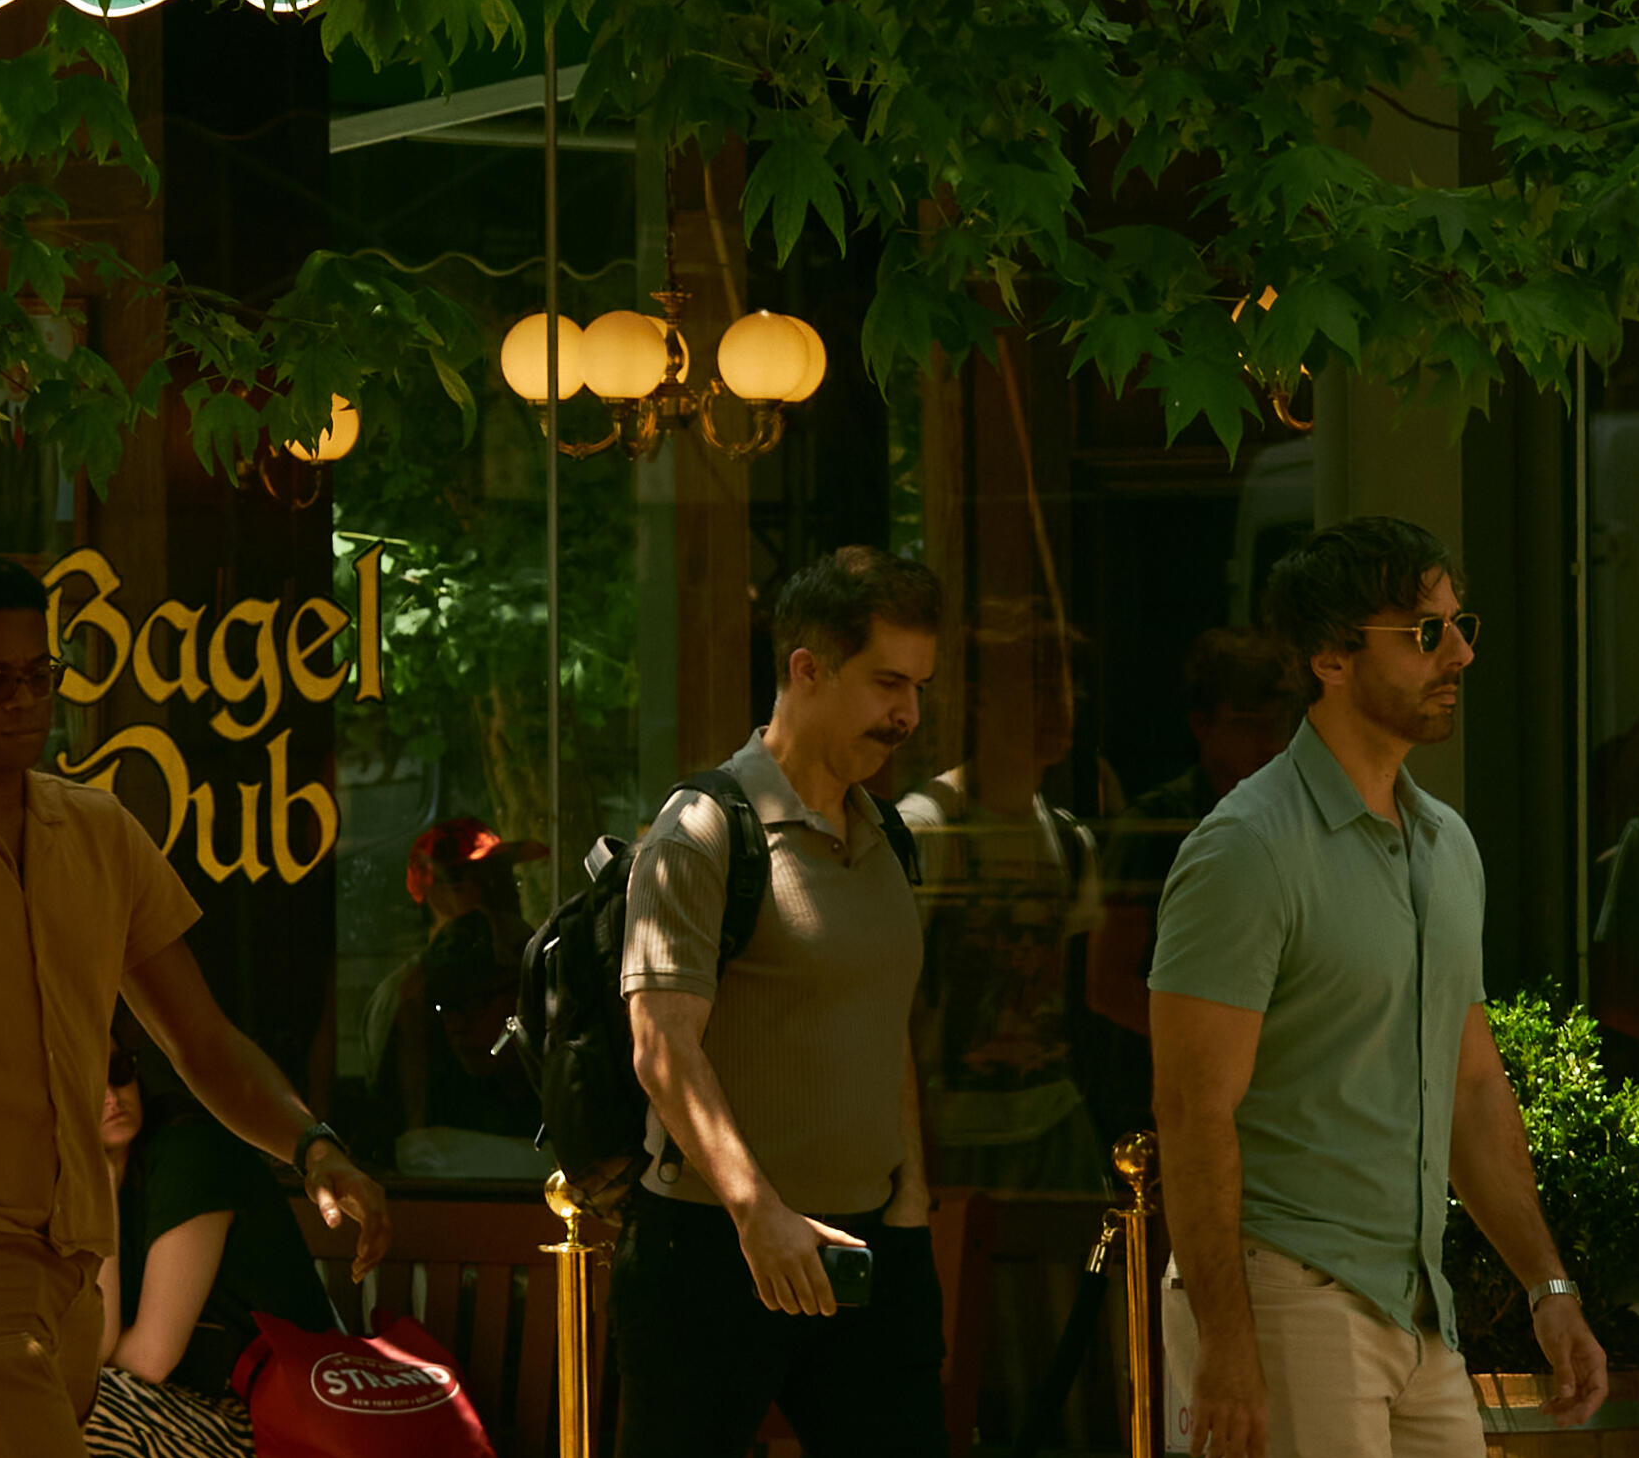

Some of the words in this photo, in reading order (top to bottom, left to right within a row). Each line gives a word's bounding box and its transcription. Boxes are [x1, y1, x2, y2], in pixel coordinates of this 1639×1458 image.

[42, 546, 385, 741] Bagel
[57, 723, 342, 884] Pub
[323, 1366, 451, 1395] STRAND
